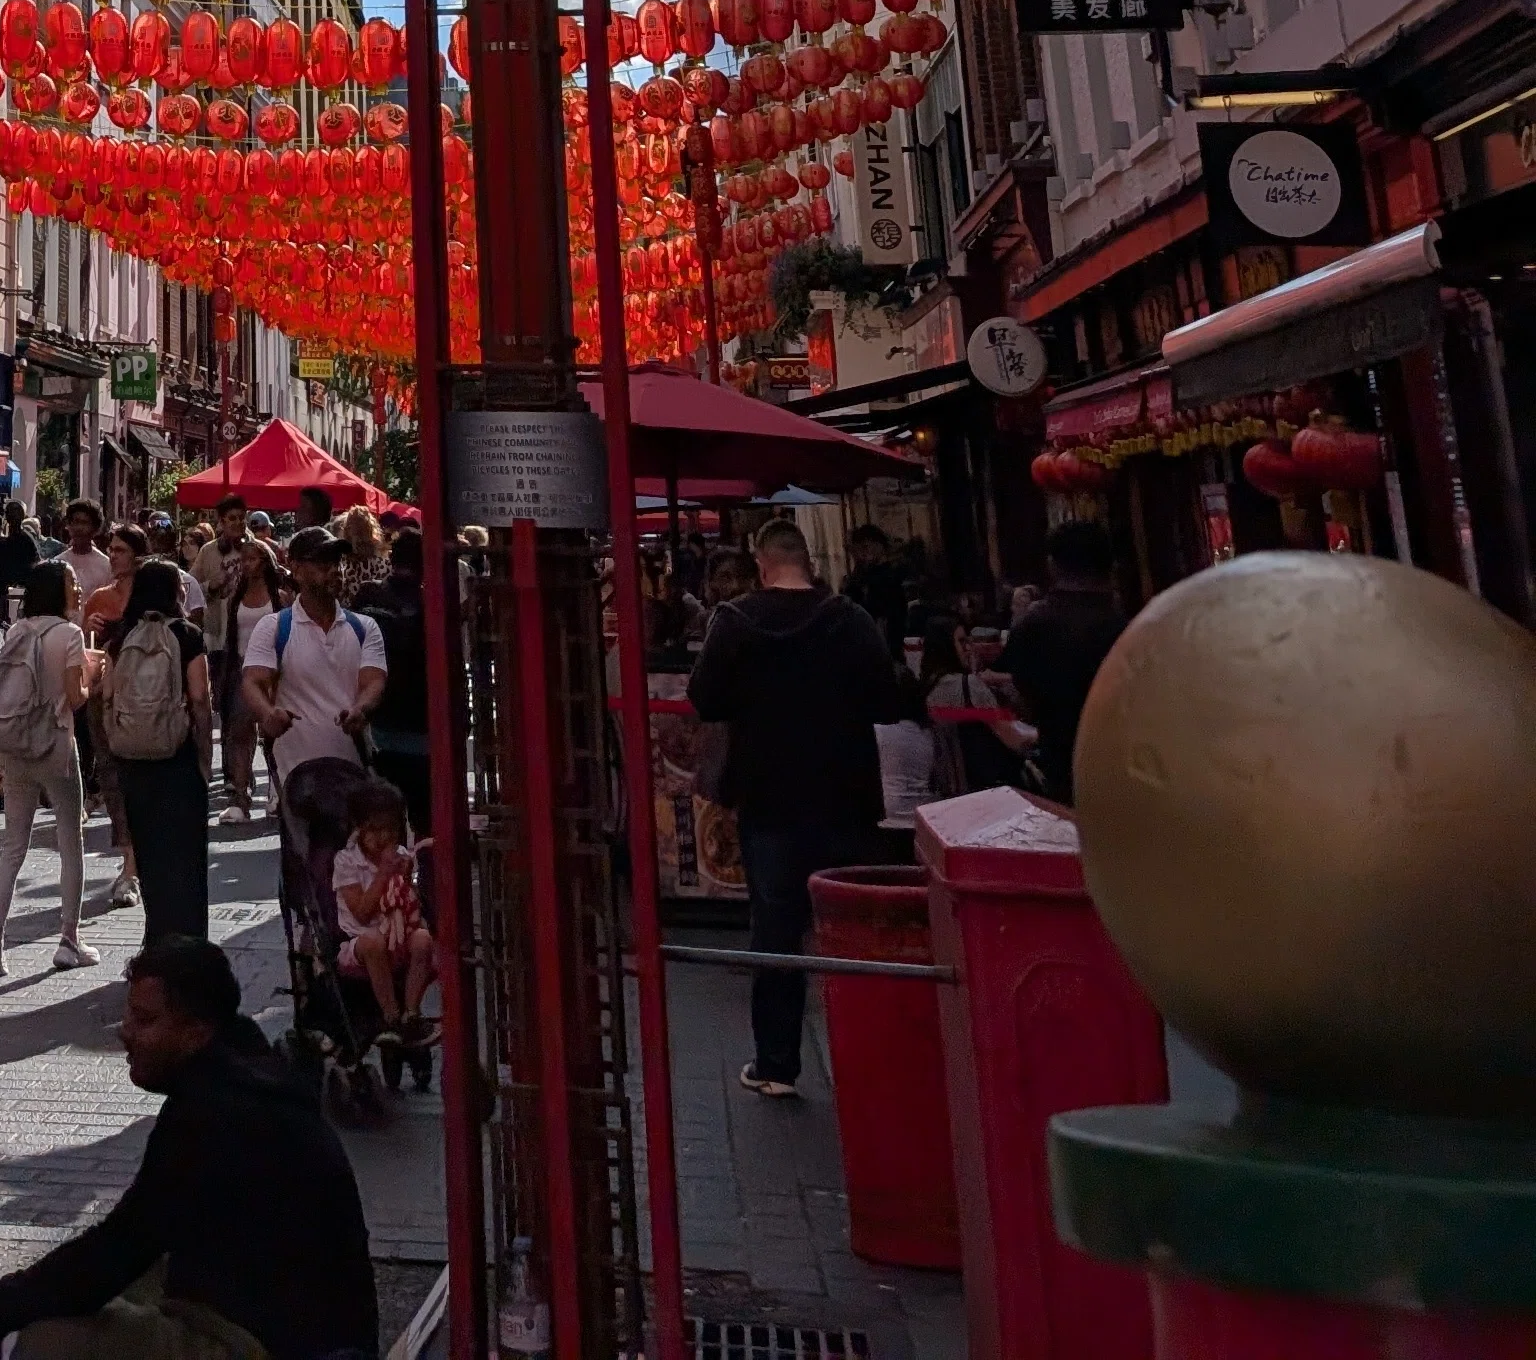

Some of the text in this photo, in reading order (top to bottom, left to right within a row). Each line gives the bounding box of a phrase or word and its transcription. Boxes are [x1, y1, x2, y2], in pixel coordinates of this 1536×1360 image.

[864, 123, 895, 210] ZHAN
[1246, 165, 1330, 182] Chatime
[480, 424, 510, 434] PLEASE
[512, 424, 547, 434] RESPECT
[467, 437, 503, 448] CHINESE
[504, 438, 560, 448] COMMUNITY
[508, 451, 534, 461] FROM
[471, 465, 510, 476] BICYCLES
[512, 465, 524, 475] TO
[525, 465, 551, 476] THESE
